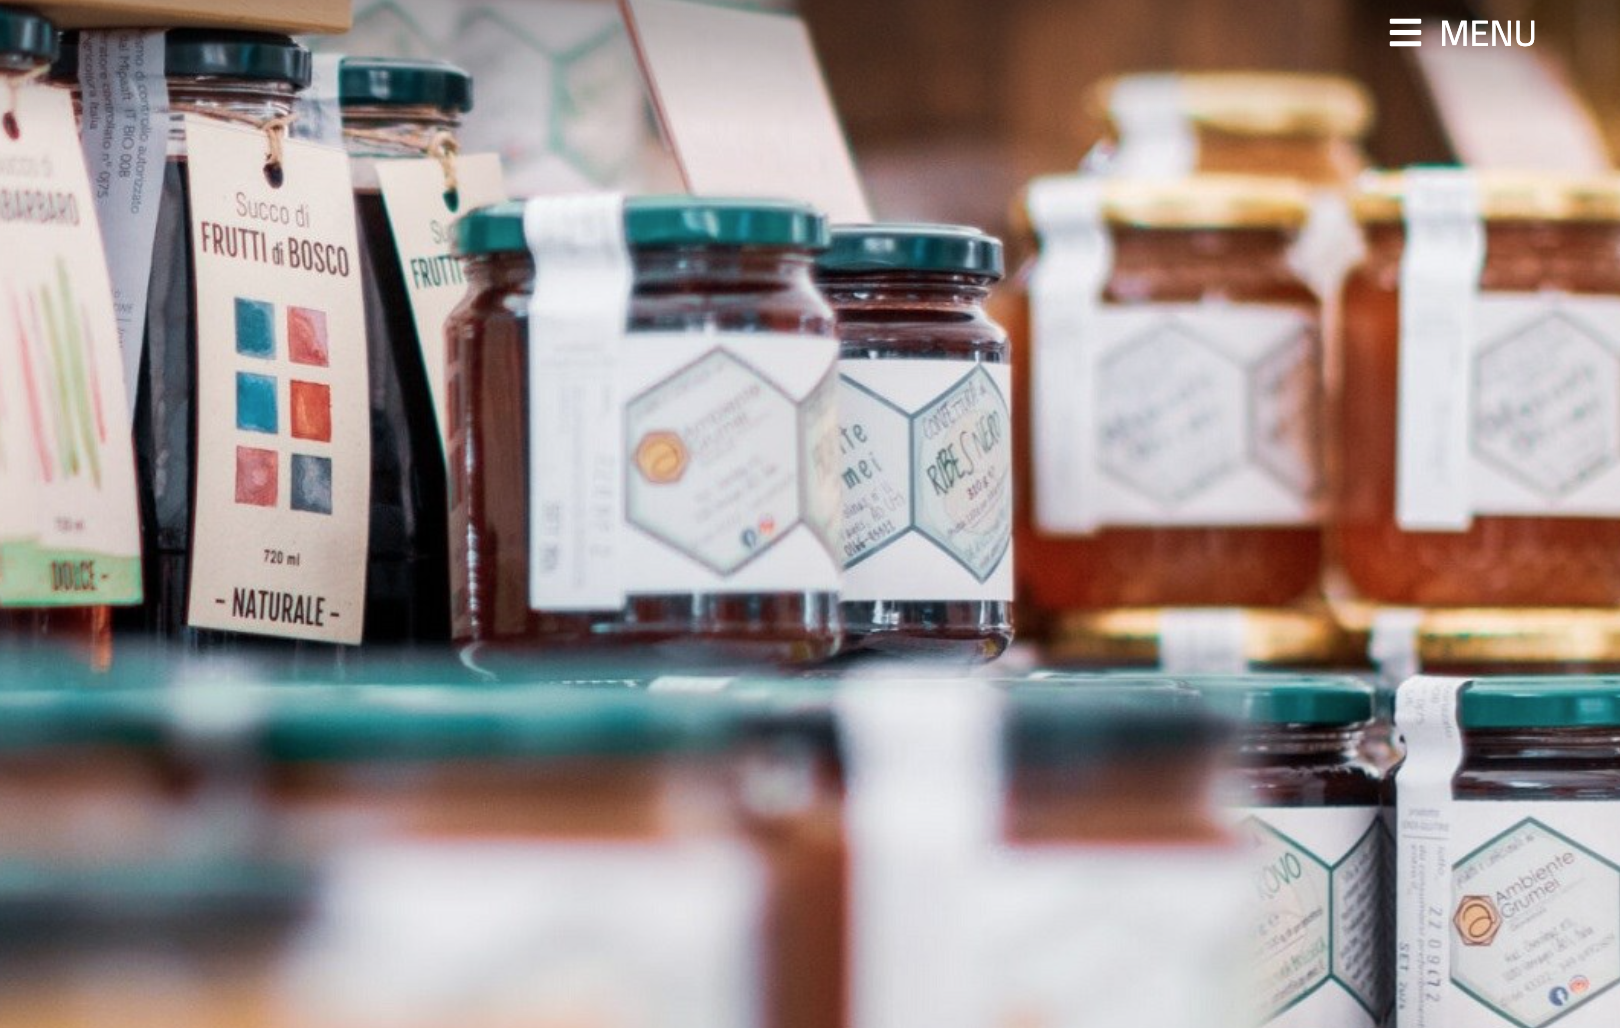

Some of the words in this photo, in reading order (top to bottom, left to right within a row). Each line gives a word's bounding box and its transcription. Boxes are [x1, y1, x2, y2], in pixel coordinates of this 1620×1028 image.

[122, 126, 136, 150] BIO
[131, 146, 148, 214] autorizzato
[236, 191, 290, 225] Succo
[295, 204, 310, 229] di
[201, 221, 268, 263] FRUTTI
[272, 242, 285, 265] di
[287, 237, 350, 277] BOSCO
[264, 549, 284, 565] 720
[286, 553, 301, 566] ml
[232, 587, 326, 627] NATURALE
[1496, 850, 1576, 904] Ambiente
[1500, 877, 1561, 920] Grumei
